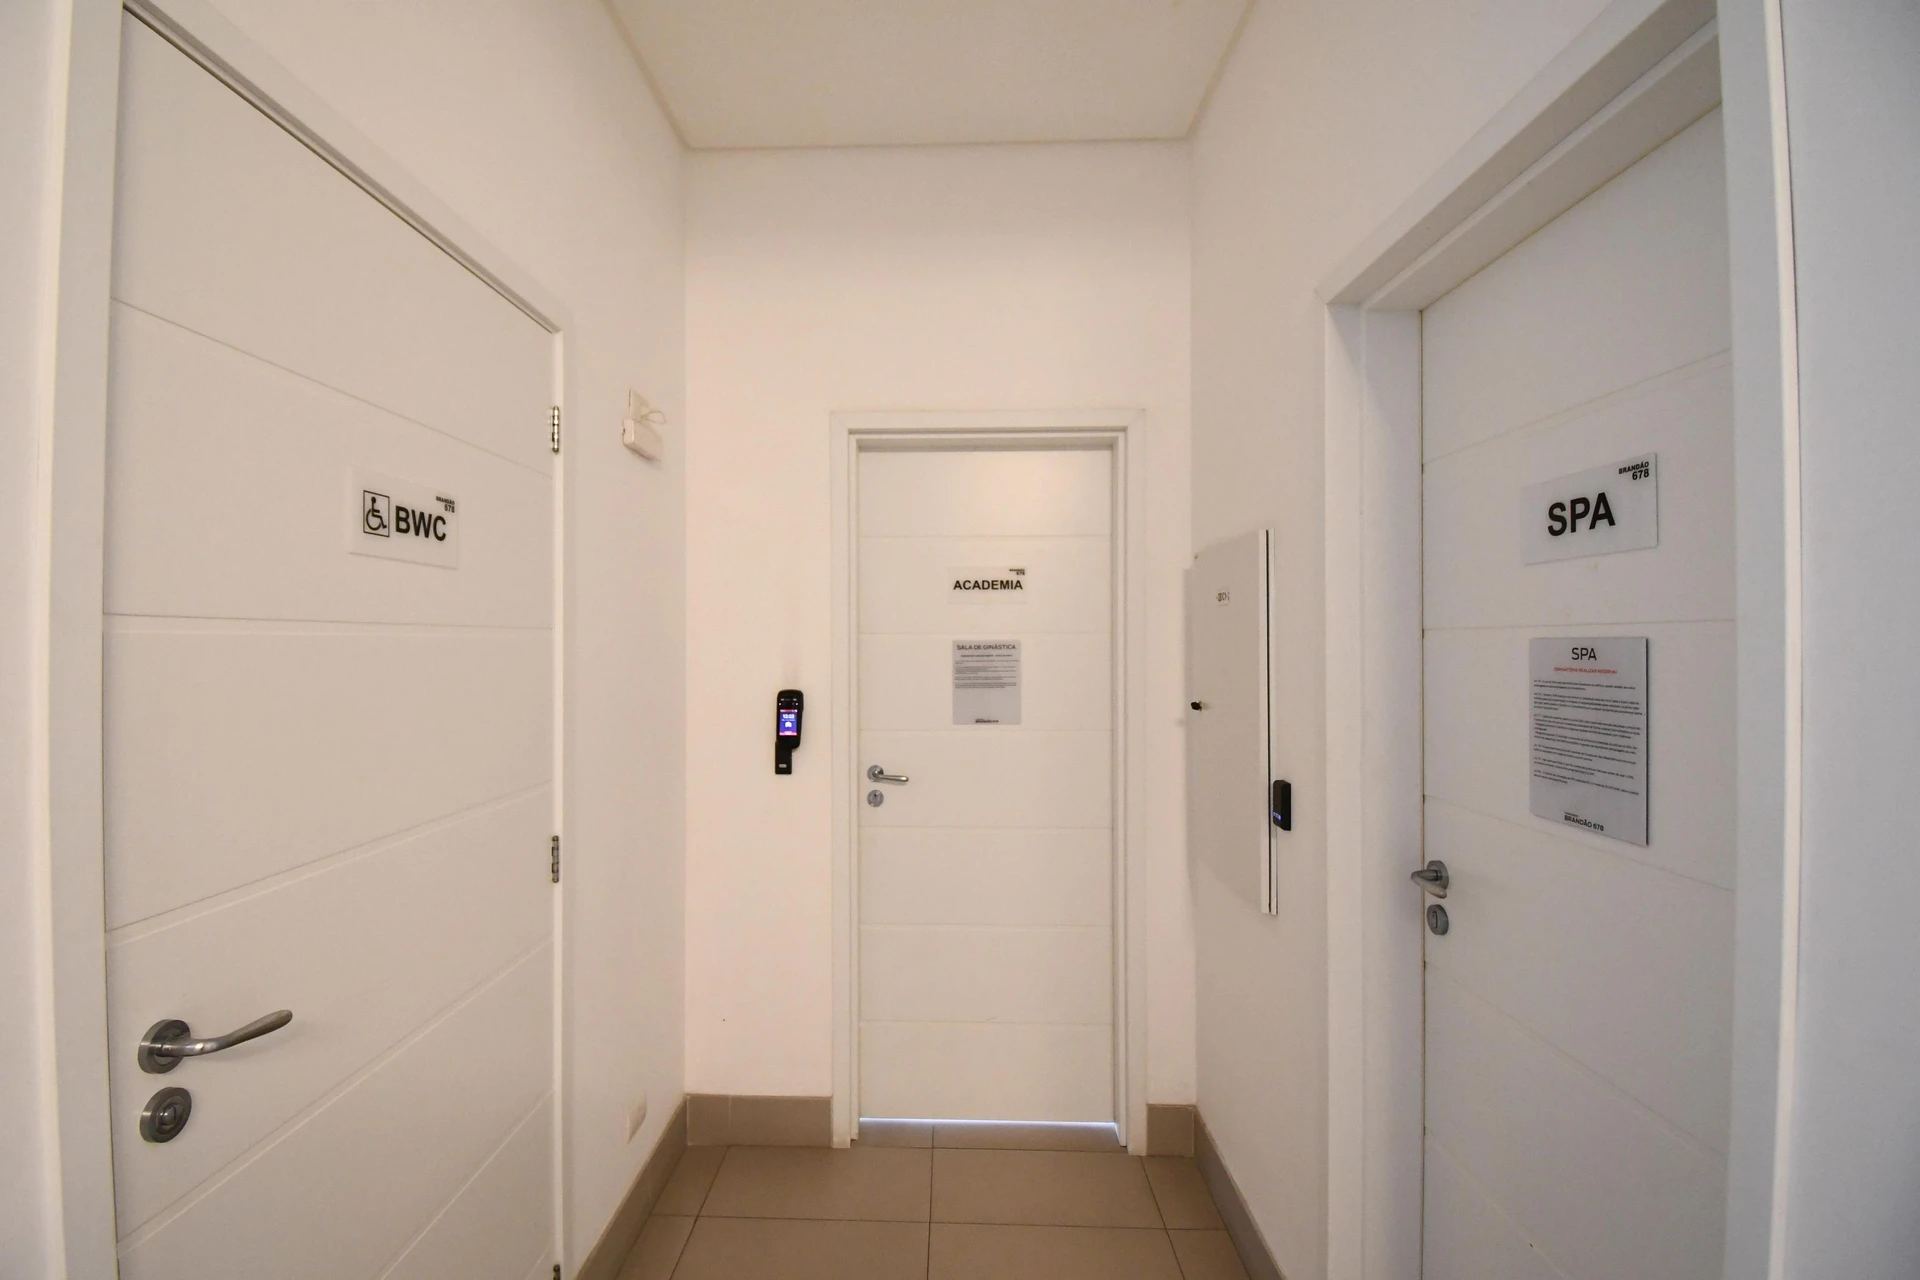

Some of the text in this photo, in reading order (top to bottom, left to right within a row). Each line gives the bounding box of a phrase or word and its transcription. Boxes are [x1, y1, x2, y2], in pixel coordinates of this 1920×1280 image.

[1618, 461, 1650, 475] BRANDÃO
[1632, 469, 1650, 480] 678
[1547, 492, 1616, 536] SPA
[395, 505, 446, 541] BWC
[953, 579, 1023, 590] ACADEMIA
[1571, 647, 1597, 661] SPA
[1564, 814, 1592, 828] BRANDÃO
[1592, 823, 1604, 831] 678
